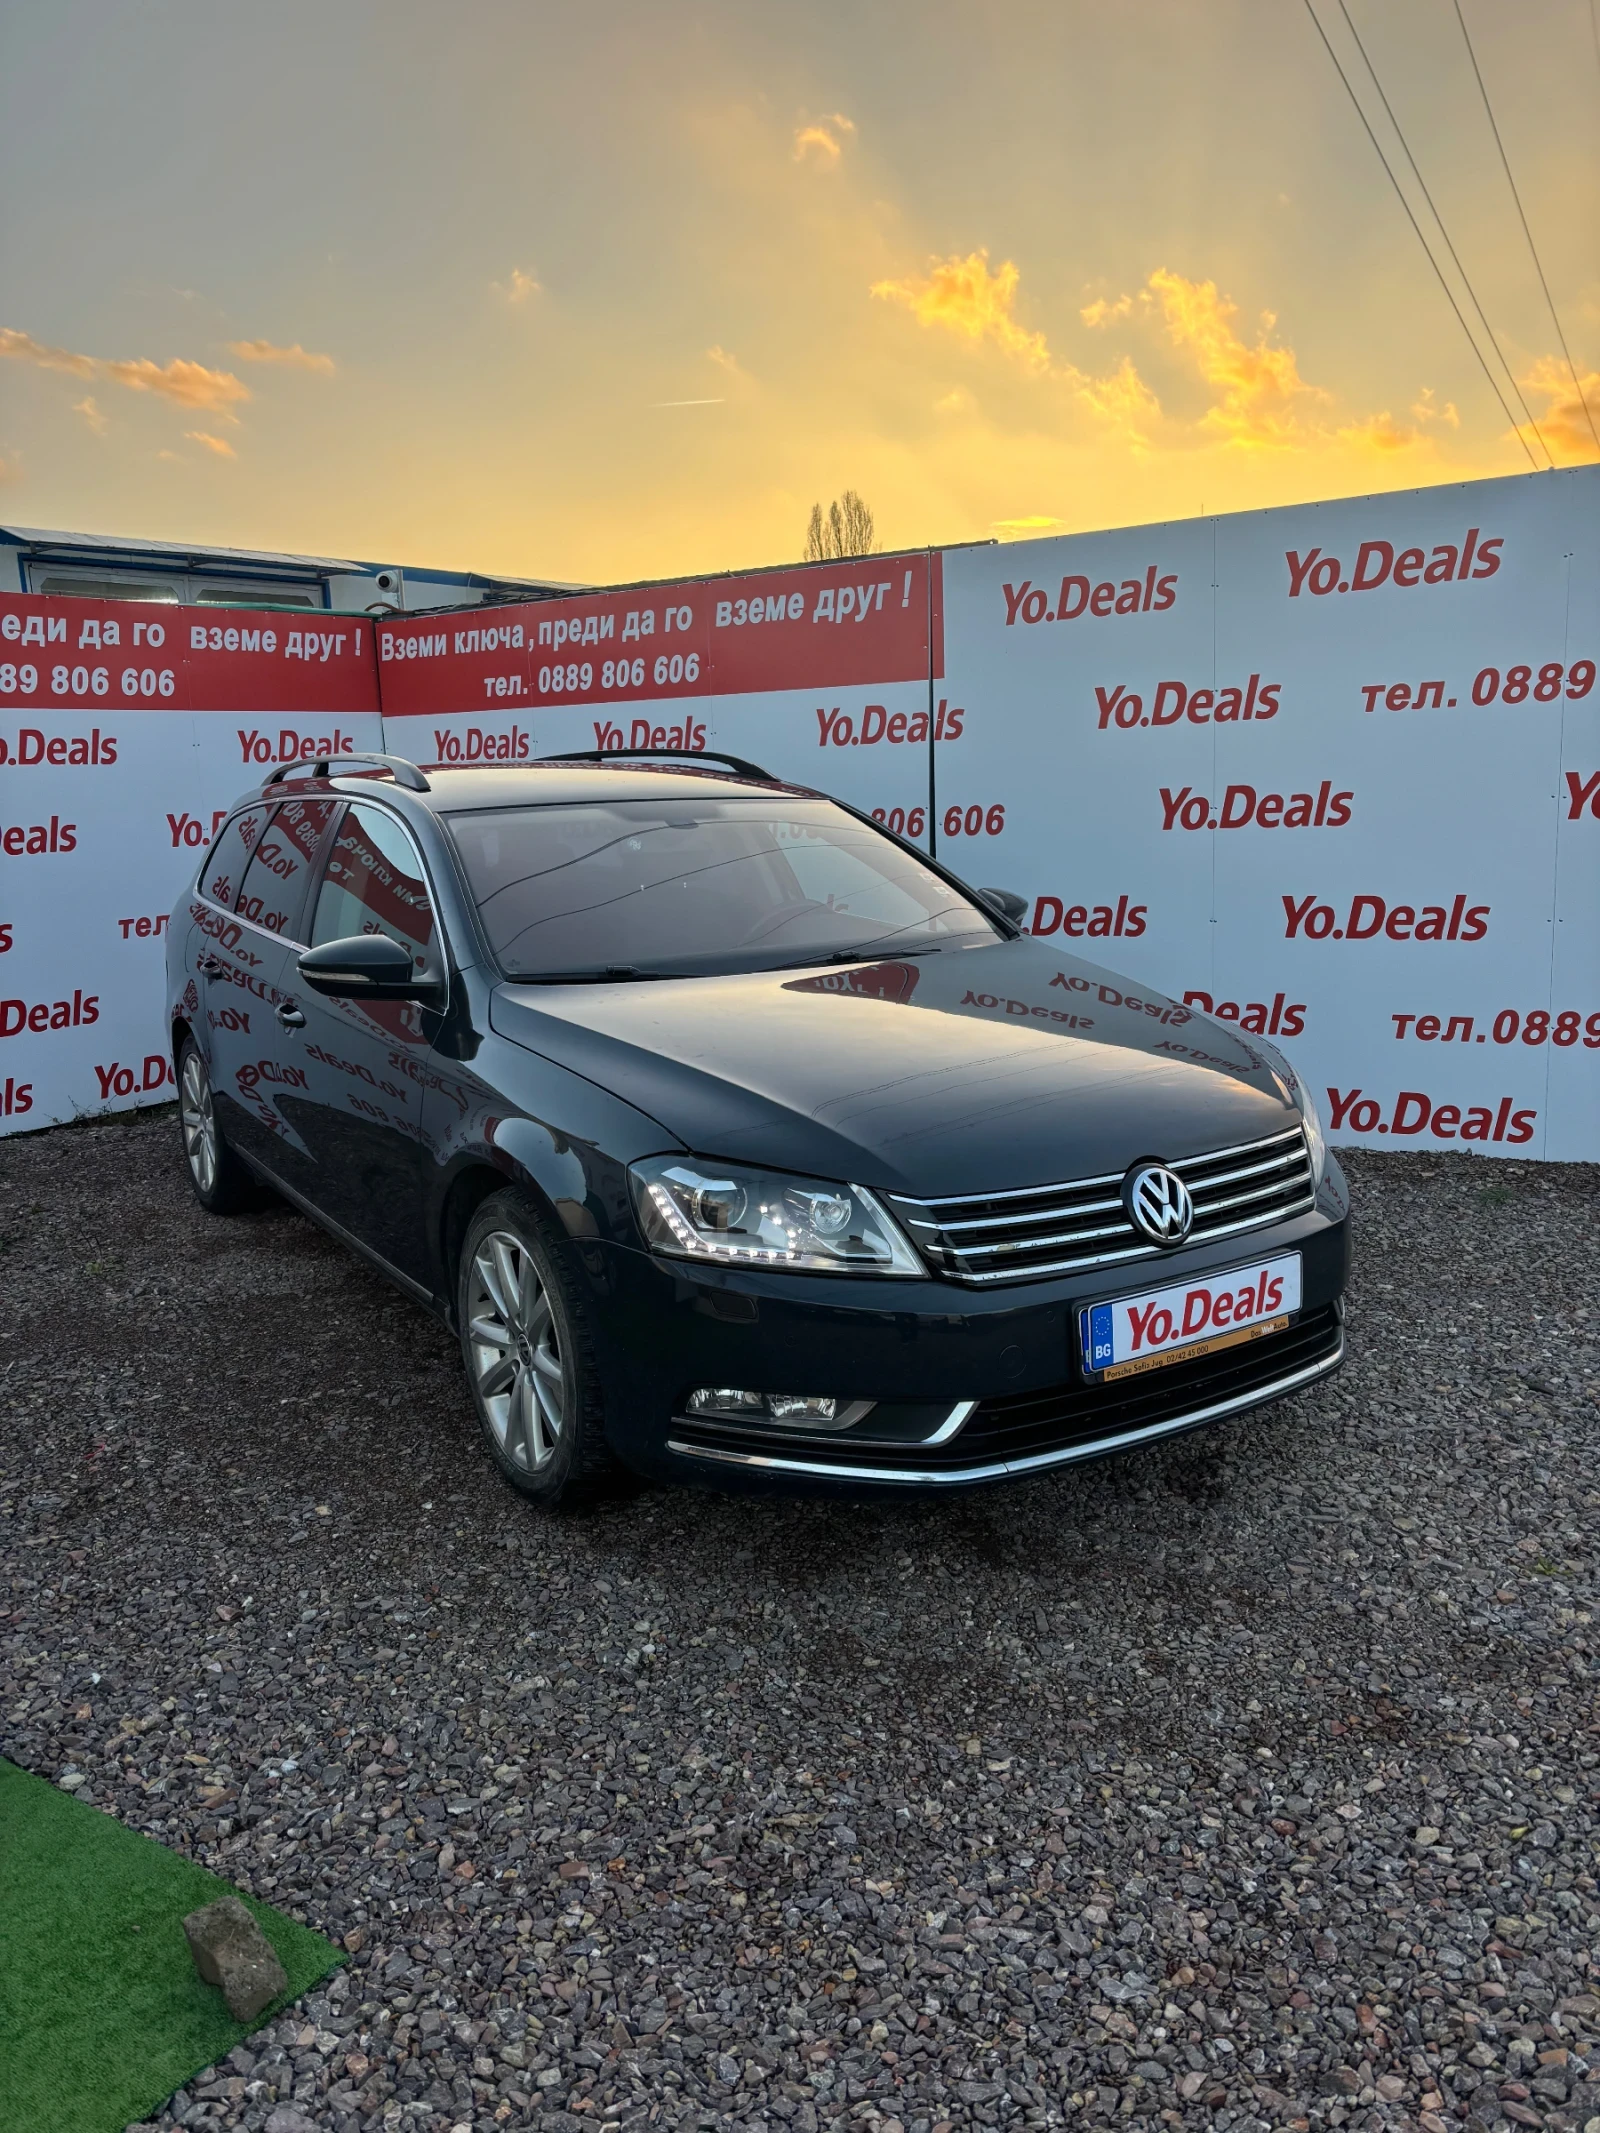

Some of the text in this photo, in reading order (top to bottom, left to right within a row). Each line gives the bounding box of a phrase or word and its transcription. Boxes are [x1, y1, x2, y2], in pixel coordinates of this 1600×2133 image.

[1286, 528, 1504, 597] Yo.Deals
[381, 633, 448, 662] Вземи
[621, 609, 656, 644] да
[663, 604, 694, 634] го
[714, 591, 806, 628] вземе
[811, 581, 892, 624] друг
[901, 569, 914, 608] !
[1002, 565, 1178, 625] Yo.Deals
[78, 618, 121, 650] да
[132, 622, 166, 648] го
[190, 625, 278, 653] вземе
[284, 631, 347, 662] друг
[354, 627, 363, 657] !
[50, 665, 110, 696] 806
[120, 667, 175, 697] 606
[483, 652, 701, 698] тел. 0889 806 606
[1361, 659, 1597, 713] тел. 0889
[816, 699, 966, 747] Yo.Deals
[1094, 673, 1282, 730] Yo.Deals
[434, 725, 529, 762] Yo.Deals
[944, 804, 1006, 837] 606
[1159, 781, 1354, 831] Yo.Deals
[1281, 894, 1491, 942] Yo.Deals
[93, 1054, 175, 1099] Yo.D
[1326, 1087, 1538, 1144] Yo.Deals
[1126, 1270, 1284, 1351] Yo.Deals
[1095, 1343, 1111, 1360] BG
